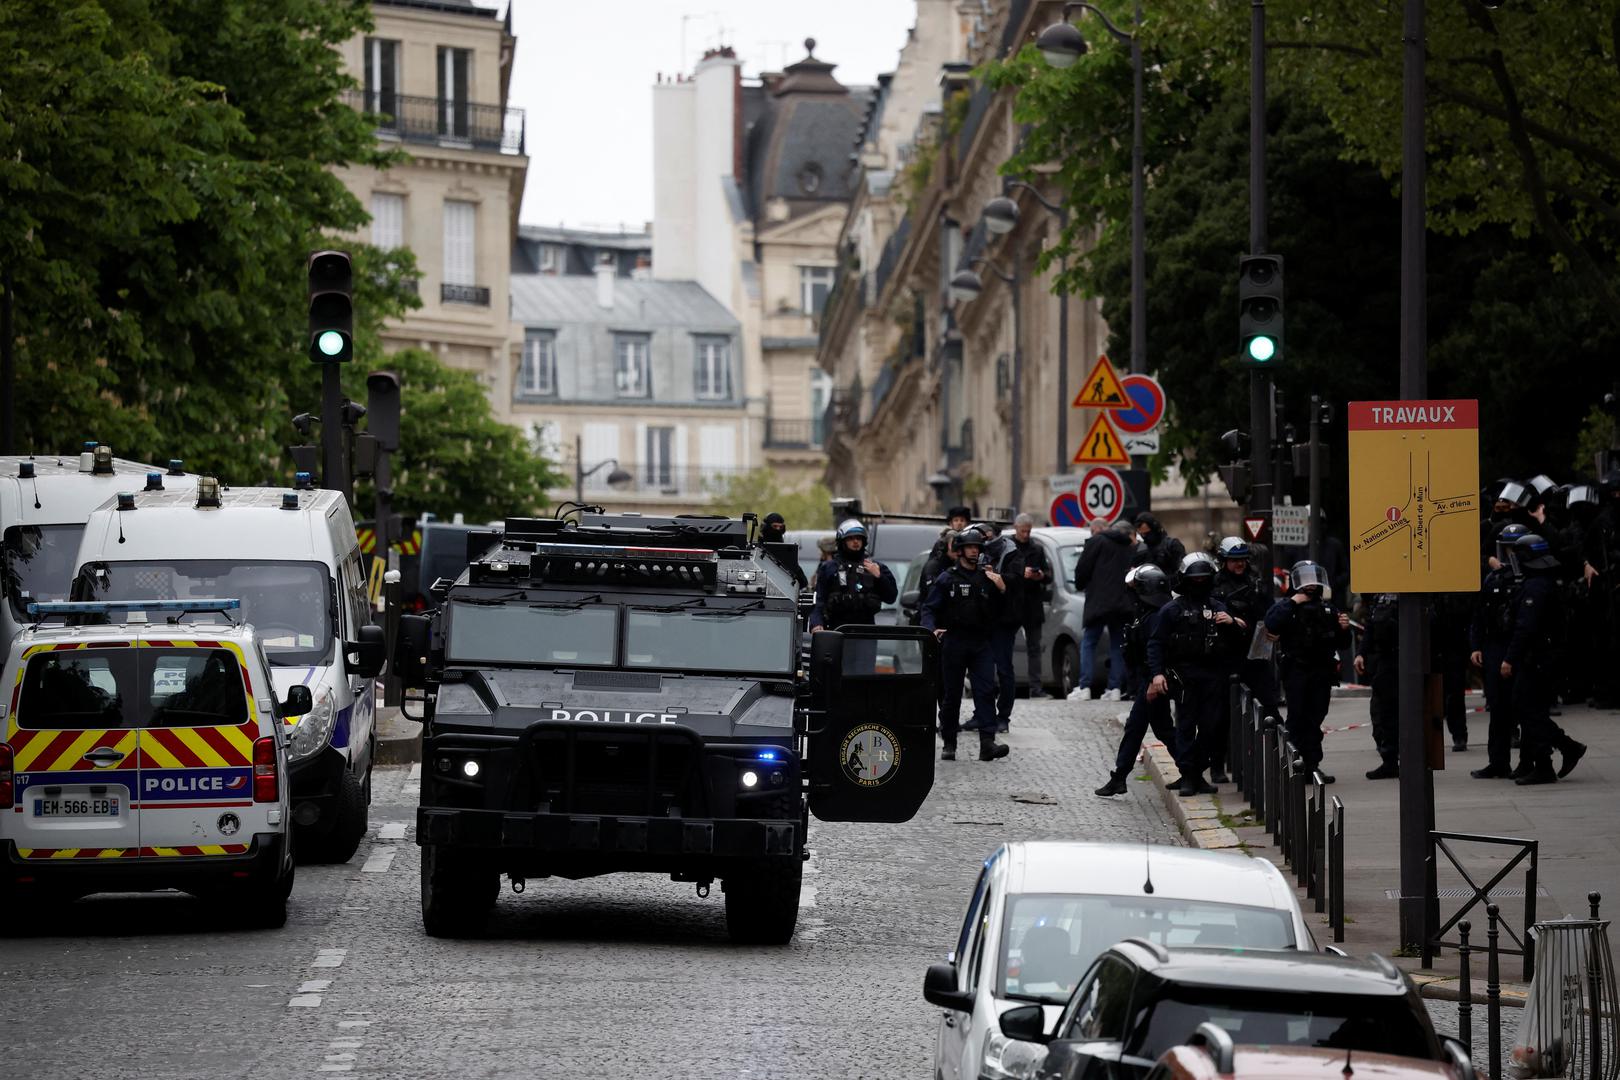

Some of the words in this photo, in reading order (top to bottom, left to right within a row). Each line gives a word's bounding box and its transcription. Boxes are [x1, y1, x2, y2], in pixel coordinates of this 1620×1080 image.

[1371, 406, 1456, 424] TRAVAUX
[1088, 483, 1115, 508] 30
[1416, 486, 1424, 502] Mun
[1416, 504, 1424, 514] de
[1436, 503, 1449, 511] Av.
[1449, 500, 1472, 509] d'Iéna
[1416, 514, 1424, 537] Albert
[1352, 543, 1364, 552] Av.
[1363, 528, 1389, 546] Nations
[1387, 517, 1408, 531] Unies
[848, 725, 879, 739] RECHERCHE
[880, 728, 900, 766] INTERVENTION
[145, 776, 223, 791] POLICE
[858, 778, 880, 786] PARIS
